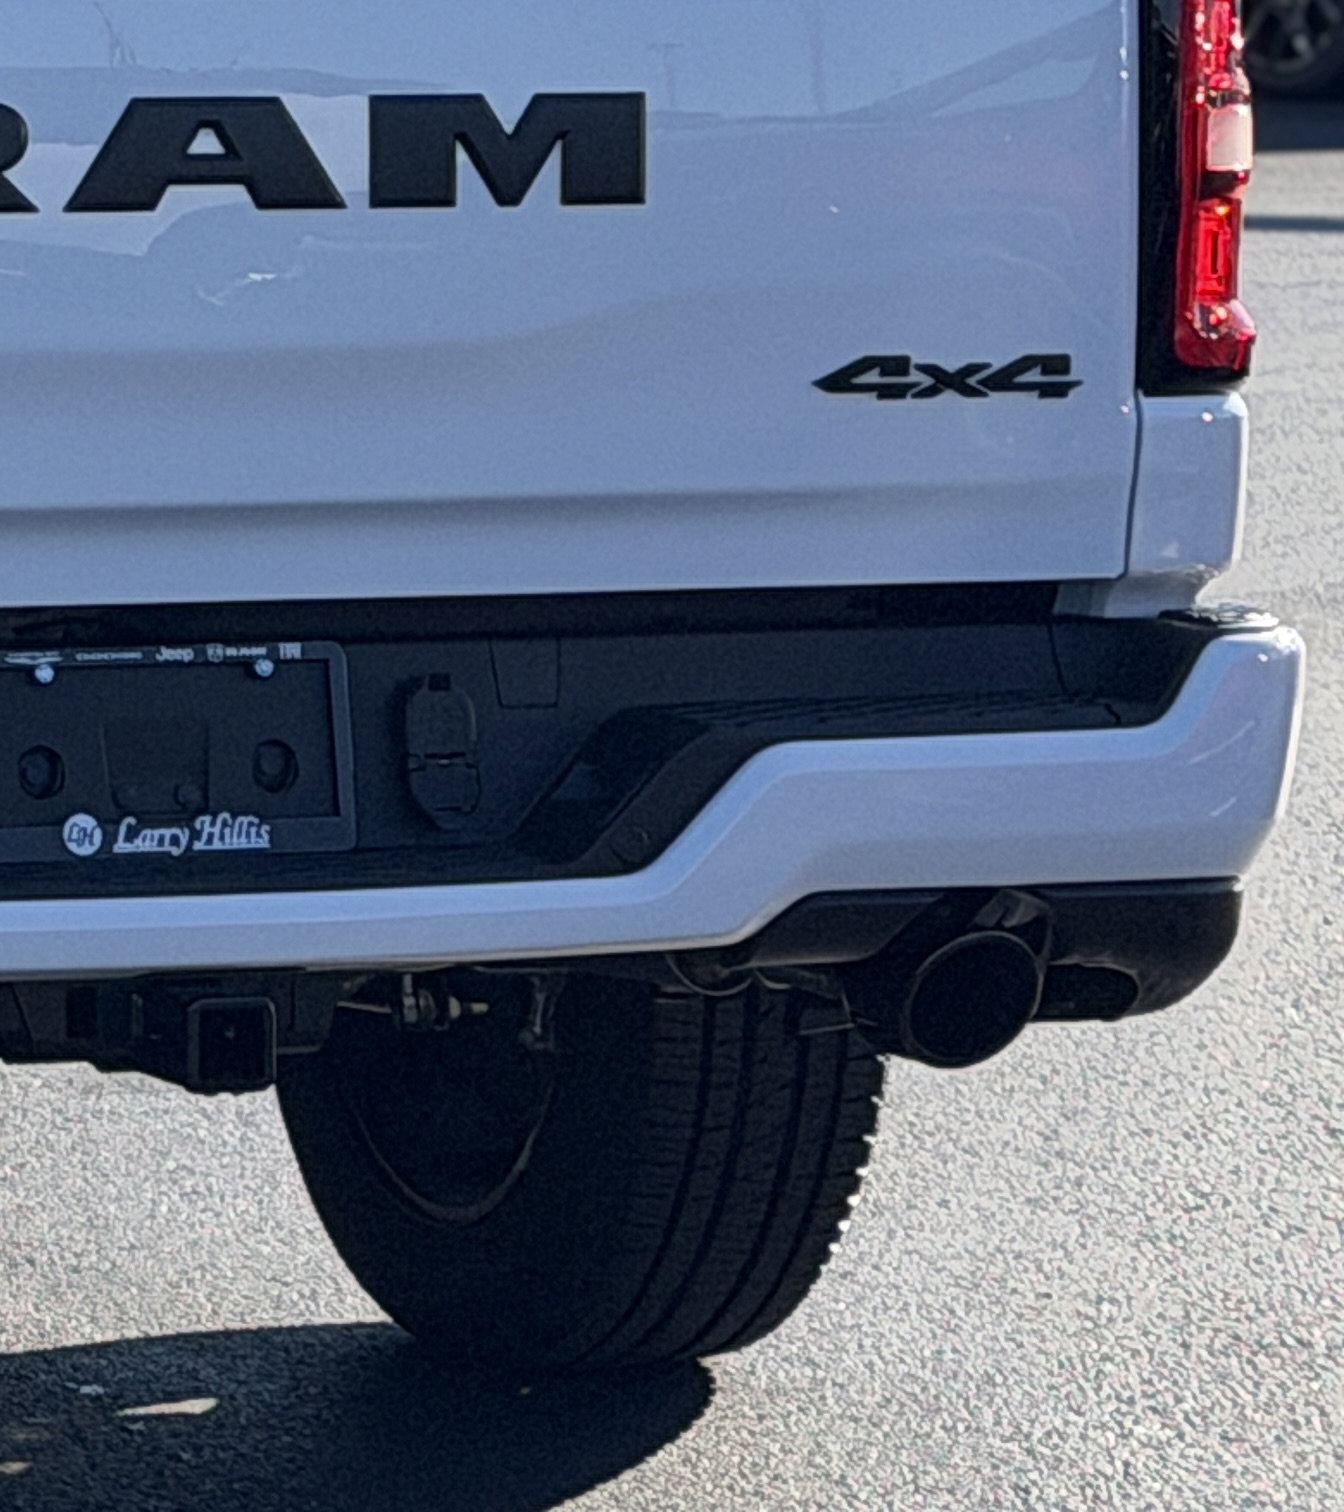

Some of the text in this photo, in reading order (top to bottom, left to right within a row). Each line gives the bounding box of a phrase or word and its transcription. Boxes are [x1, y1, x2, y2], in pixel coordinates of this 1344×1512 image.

[811, 353, 1084, 400] 4x4
[155, 645, 195, 663] Jeep
[113, 811, 271, 856] Larry Hillis
